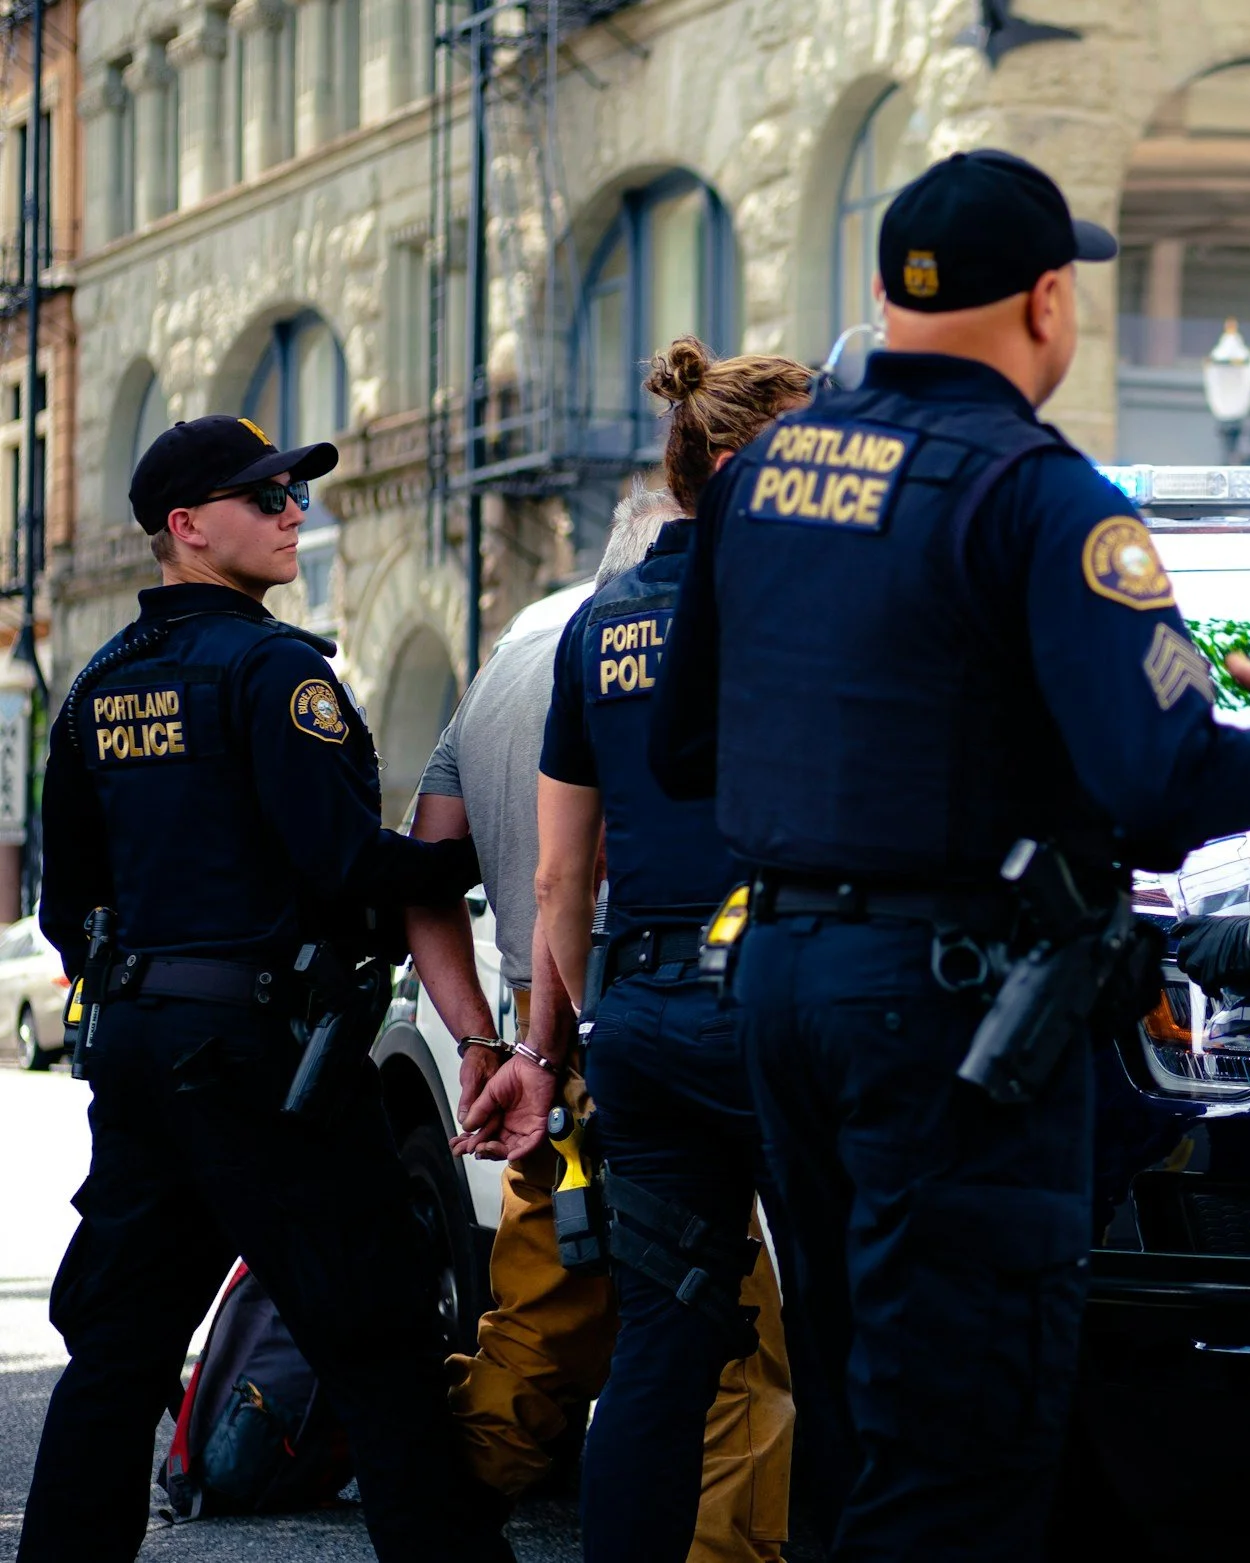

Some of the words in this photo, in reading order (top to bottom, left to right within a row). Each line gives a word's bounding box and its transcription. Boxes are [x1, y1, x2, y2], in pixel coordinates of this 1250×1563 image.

[766, 424, 905, 473] PORTLAND
[751, 466, 889, 525] POLICE
[600, 652, 663, 694] POL
[94, 691, 179, 723] PORTLAND
[97, 722, 185, 760] POLICE
